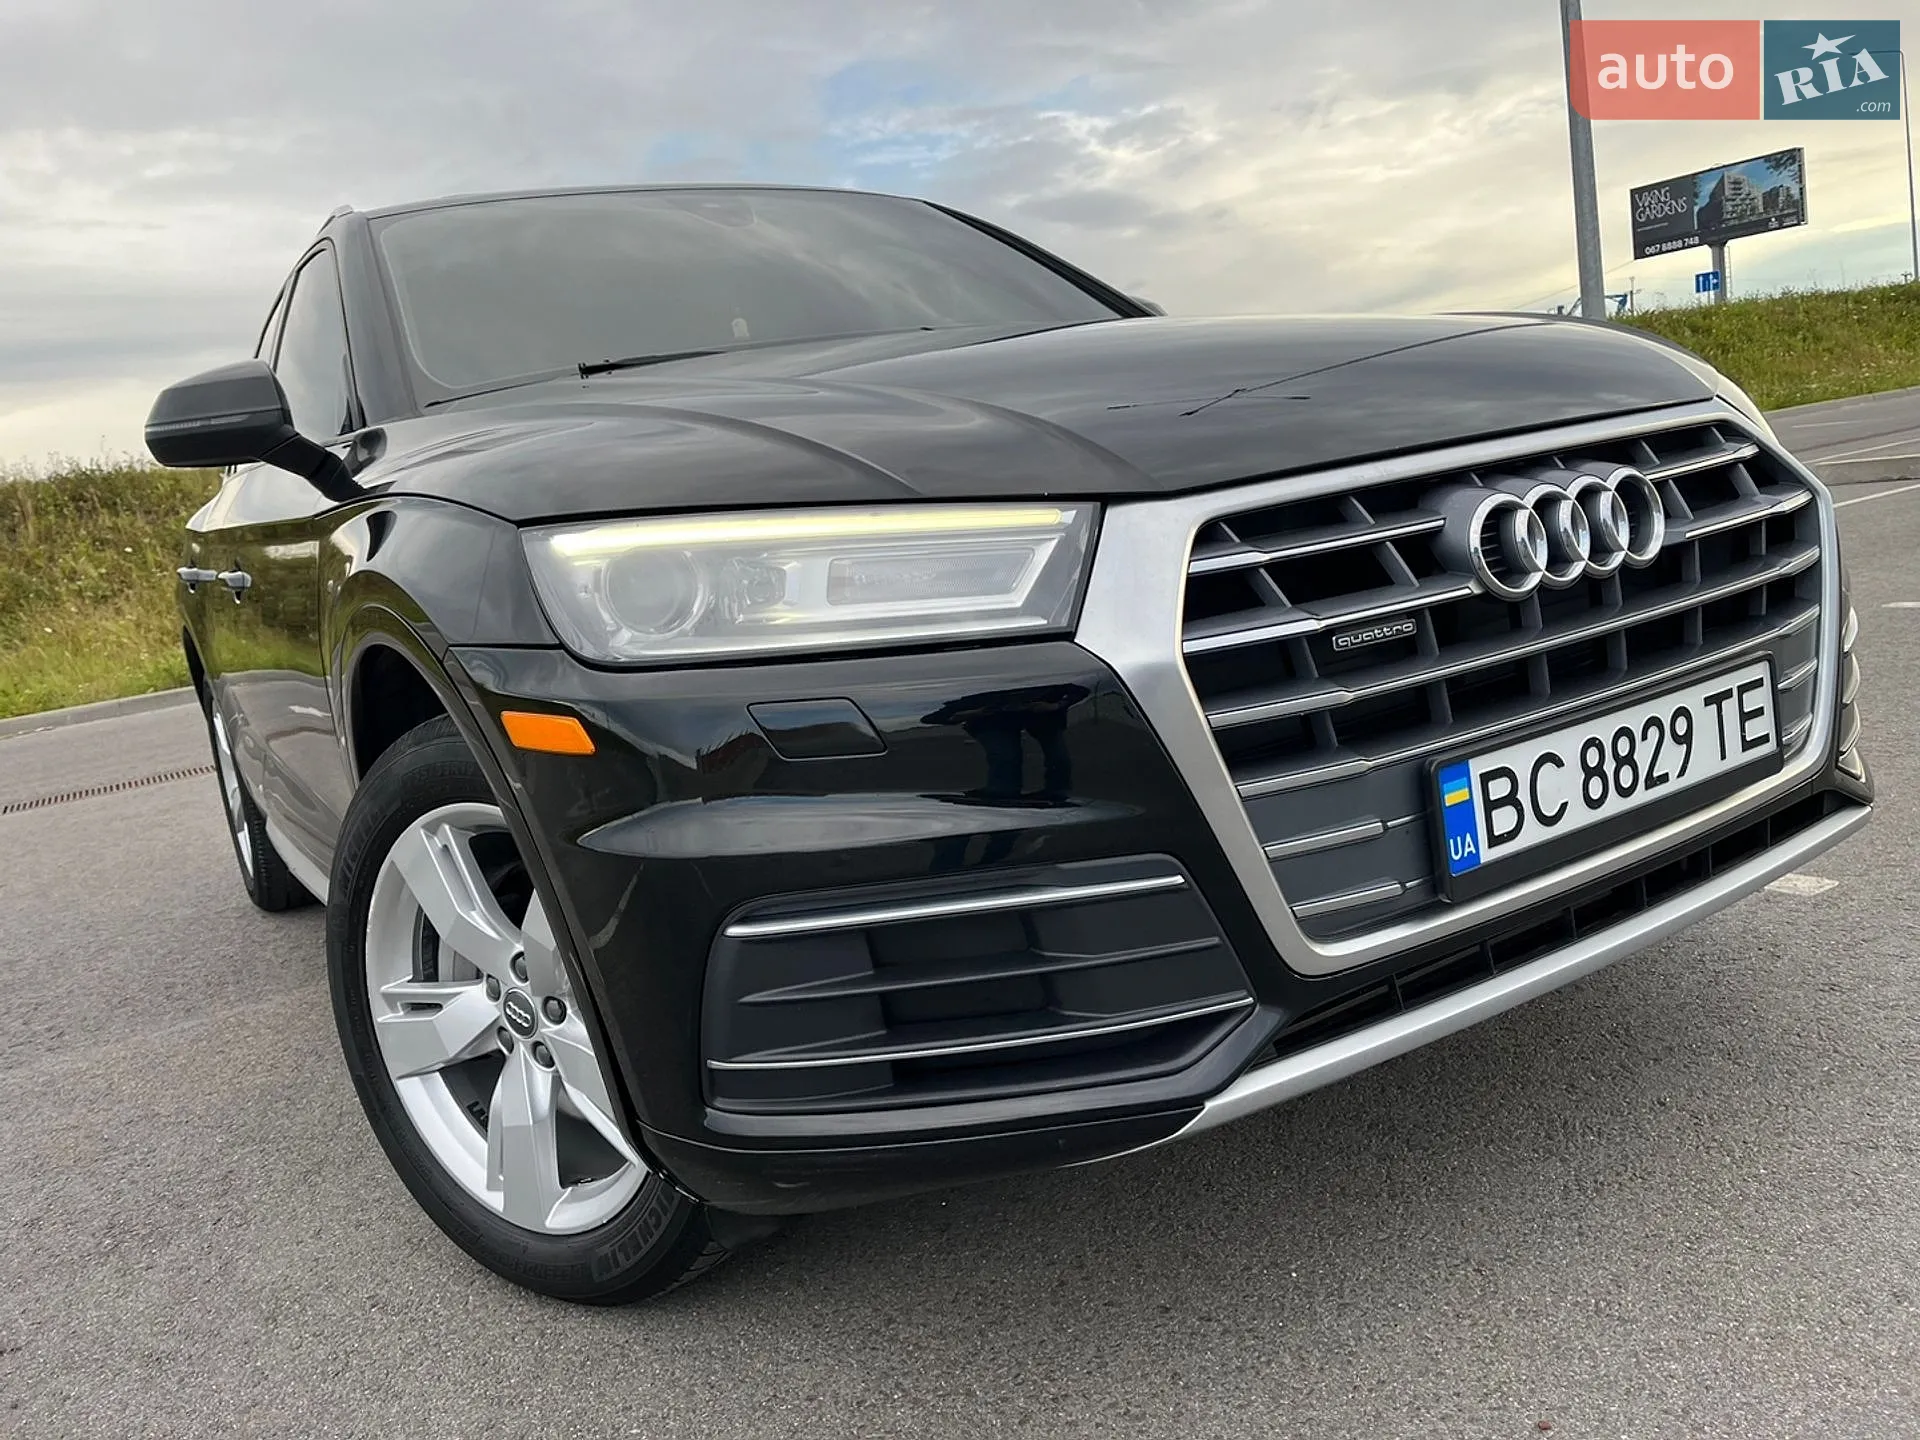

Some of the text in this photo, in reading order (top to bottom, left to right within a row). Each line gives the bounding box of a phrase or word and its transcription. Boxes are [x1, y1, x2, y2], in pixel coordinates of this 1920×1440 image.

[1635, 196, 1688, 222] GARDENS
[1337, 622, 1413, 647] quattro
[1479, 676, 1770, 849] BC 8829 TE
[1450, 831, 1476, 860] UA
